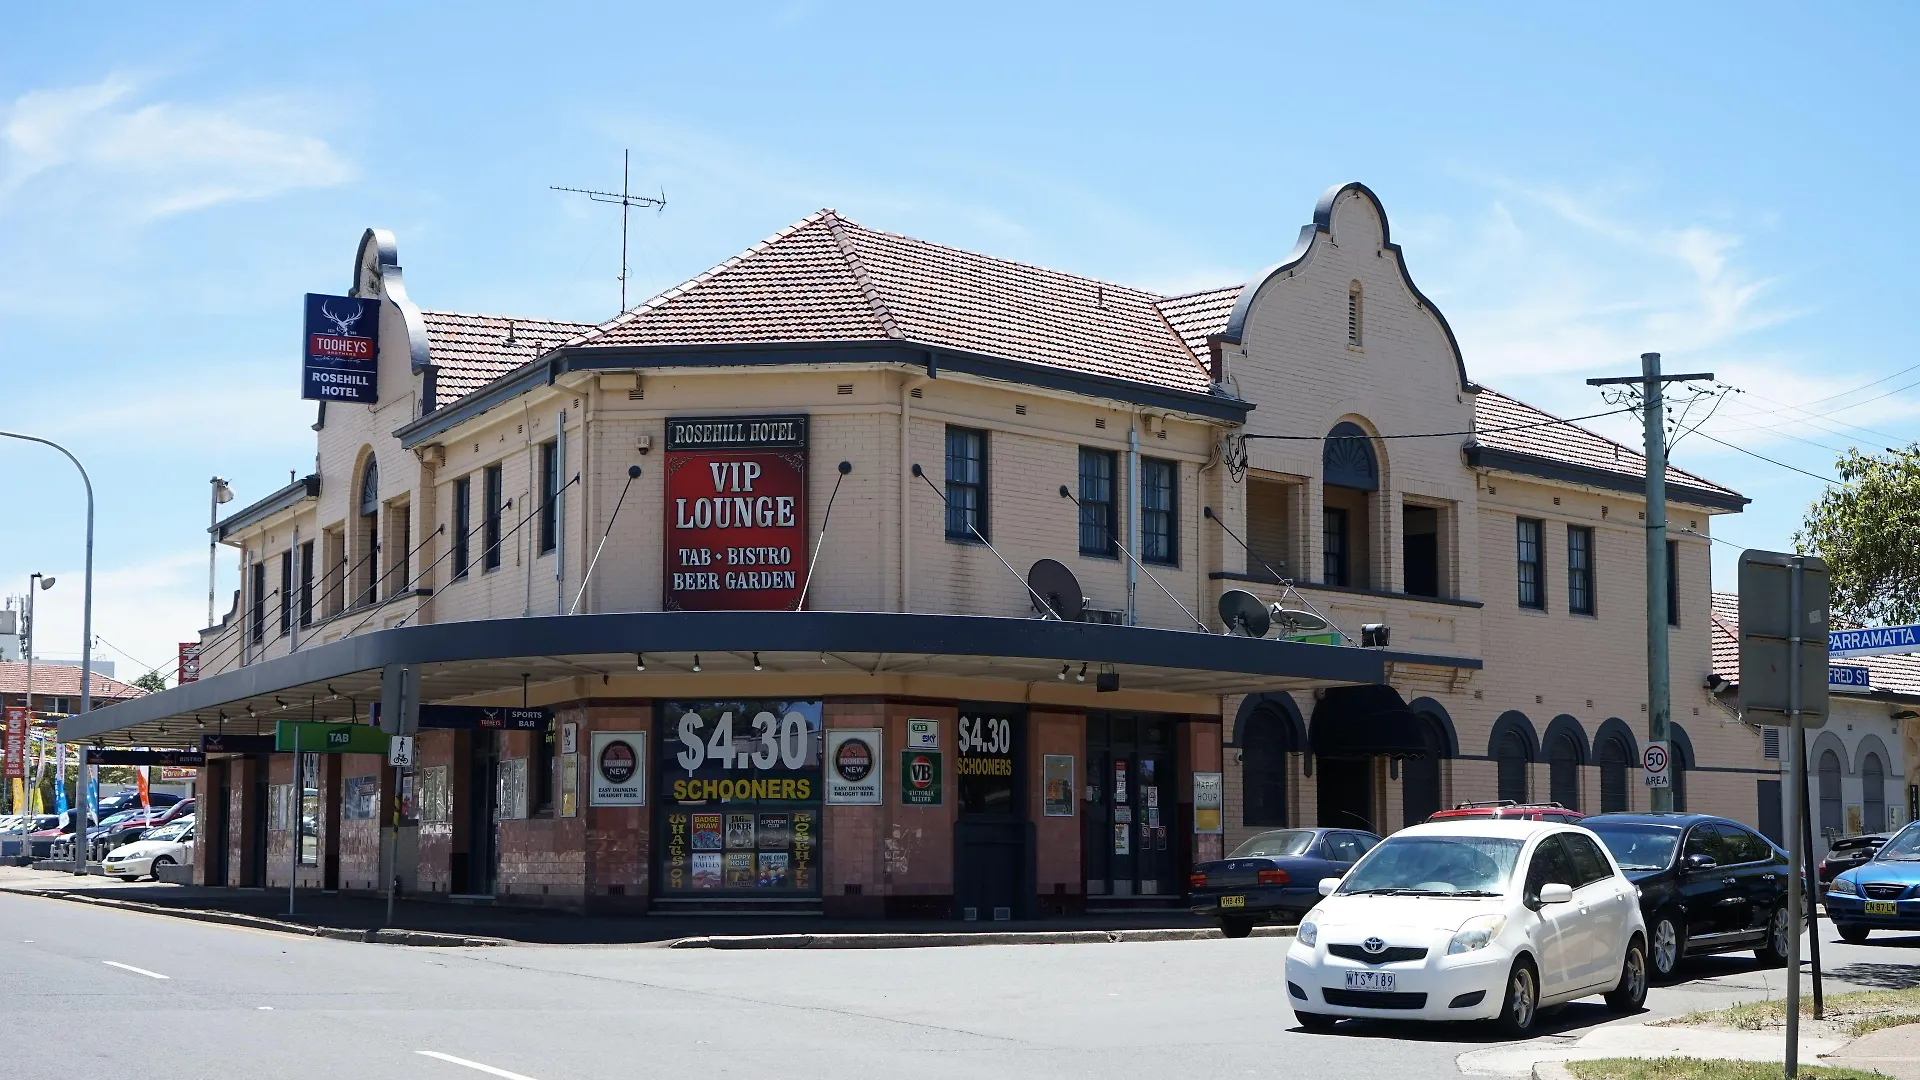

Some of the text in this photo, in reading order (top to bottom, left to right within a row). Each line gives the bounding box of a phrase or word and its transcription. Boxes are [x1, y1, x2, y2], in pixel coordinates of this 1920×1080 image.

[316, 337, 367, 353] TOOHEYS
[312, 372, 369, 386] ROSEHILL
[321, 385, 359, 397] HOTEL
[675, 422, 797, 444] ROSEHILL HOTEL
[709, 461, 761, 493] VIP
[675, 496, 795, 529] LOUNGE
[678, 546, 791, 567] TAB BISTRO
[673, 570, 796, 591] BEER GARDEN
[1829, 627, 1916, 650] PARRAMATTA
[1856, 669, 1867, 685] ST
[511, 710, 543, 719] SPORTS
[518, 720, 535, 728] BAR
[329, 733, 349, 743] TAB
[676, 708, 808, 778] $4.30
[958, 715, 1011, 757] $4.30
[603, 759, 633, 767] TOOHEYS
[840, 757, 868, 765] TOOHEYS
[957, 757, 1012, 776] SCHOONERS
[1647, 752, 1664, 767] 50
[609, 767, 628, 775] NEW
[911, 764, 931, 781] VB
[1196, 781, 1219, 790] HAPPY
[1645, 775, 1668, 786] AREA
[673, 778, 811, 800] SCHOONERS
[1197, 792, 1217, 801] HOUR
[731, 815, 744, 823] JAG
[728, 823, 752, 831] JOKER
[1865, 903, 1874, 911] CN
[1886, 904, 1896, 912] LW
[1346, 972, 1393, 987] WTS 189
